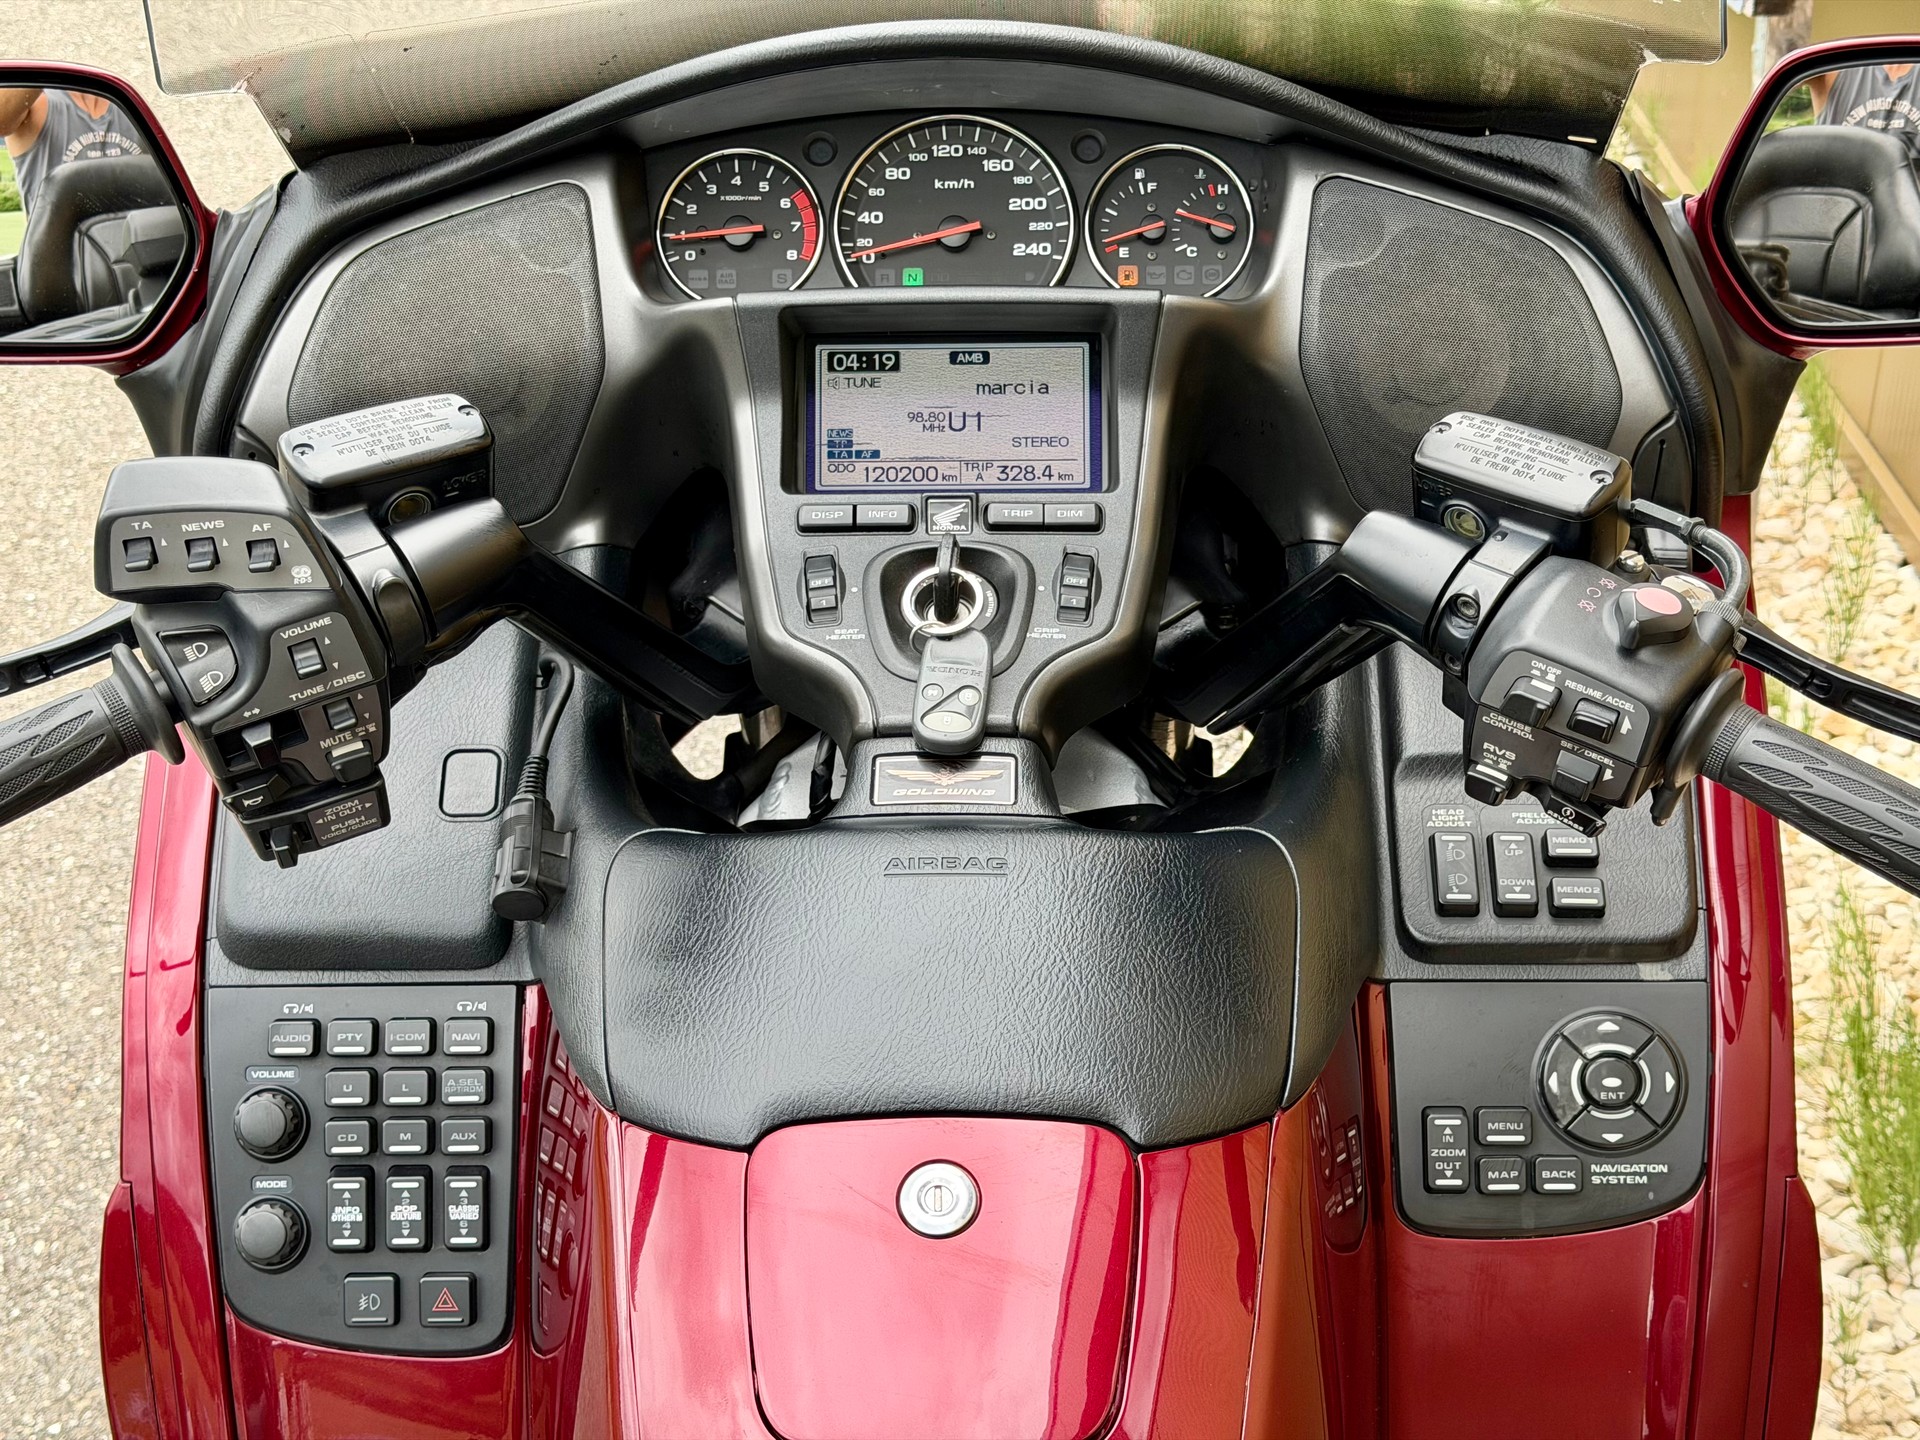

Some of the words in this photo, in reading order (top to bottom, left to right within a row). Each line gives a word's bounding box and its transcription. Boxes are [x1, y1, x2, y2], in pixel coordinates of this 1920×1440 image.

[931, 144, 964, 157] 120
[966, 146, 987, 156] 140
[908, 153, 928, 162] 100
[982, 159, 1014, 172] 160
[884, 168, 911, 180] 80
[730, 175, 742, 186] 4
[934, 179, 975, 189] km/h
[1012, 176, 1033, 185] 180
[706, 184, 717, 195] 3
[758, 181, 770, 192] 5
[1146, 182, 1158, 193] F
[1217, 184, 1229, 195] H
[868, 188, 885, 197] 60
[780, 198, 791, 208] 6
[1008, 198, 1047, 211] 200
[686, 204, 698, 214] 2
[857, 211, 884, 224] 40
[790, 222, 802, 232] 7
[1028, 222, 1053, 231] 220
[856, 238, 873, 247] 20
[786, 250, 798, 260] 8
[1012, 243, 1052, 256] 240
[1118, 247, 1130, 258] E
[1186, 246, 1198, 257] C
[684, 250, 696, 261] 0
[862, 251, 876, 264] 0
[776, 274, 788, 284] S
[907, 273, 918, 282] N
[833, 353, 896, 371] 04:19
[956, 352, 984, 364] AMB
[844, 377, 882, 389] TUNE
[976, 381, 1050, 395] marcia
[907, 412, 946, 423] 98.80
[948, 412, 982, 432] U1
[423, 423, 452, 434] FLUIDE
[828, 429, 854, 438] NEWS
[922, 423, 946, 433] MHz
[1012, 436, 1070, 448] STEREO
[365, 449, 378, 457] DE
[833, 450, 848, 458] TA
[861, 450, 873, 458] AF
[1495, 445, 1538, 462] WARNING
[1470, 456, 1483, 464] DE
[1485, 460, 1510, 472] FREIN
[827, 464, 856, 473] ODO
[864, 466, 939, 483] 120200
[942, 472, 958, 482] km
[964, 462, 994, 472] TRIP
[996, 465, 1054, 482] 328.4
[1058, 471, 1074, 481] km
[976, 472, 985, 482] A
[1537, 467, 1567, 482] FLUIDE
[812, 511, 844, 519] DISP
[868, 510, 898, 518] INFO
[1002, 509, 1033, 518] TRIP
[1056, 509, 1083, 518] DIM
[131, 521, 153, 531] TA
[182, 520, 225, 532] NEWS
[252, 523, 272, 533] AF
[280, 617, 333, 639] VOLUME
[926, 666, 984, 678] HONDA
[1531, 660, 1546, 671] ON
[1546, 665, 1562, 676] OFF
[289, 671, 366, 701] TUNE/DISC
[1564, 679, 1636, 713] RESUME/ACCEL
[1489, 712, 1532, 734] CRUISE
[1482, 716, 1535, 742] CONTROL
[320, 732, 353, 749] MUTE
[1483, 742, 1516, 760] RVS
[1560, 740, 1616, 767] SET/DECEL
[1483, 752, 1498, 761] ON
[1498, 758, 1512, 766] OFF
[892, 788, 996, 797] GOLDWING
[324, 800, 360, 815] ZOOM
[339, 805, 363, 817] OUT
[331, 816, 365, 832] PUSH
[1547, 810, 1584, 831] REVERSE
[321, 818, 378, 840] VOICE/GUIDE
[884, 856, 1009, 871] AIRBAG
[272, 1034, 311, 1042] AUDIO
[337, 1033, 363, 1042] PTY
[451, 1032, 480, 1041] NAVI
[251, 1070, 295, 1078] VOLUME
[342, 1084, 352, 1092] U
[401, 1083, 409, 1091] L
[1487, 1122, 1524, 1130] MENU
[337, 1134, 358, 1142] CD
[400, 1132, 412, 1141] M
[450, 1132, 477, 1140] AUX
[1435, 1162, 1462, 1170] OUT
[1590, 1164, 1668, 1173] NAVIGATION
[1488, 1170, 1519, 1179] MAP
[1542, 1170, 1576, 1178] BACK
[1591, 1175, 1648, 1184] SYSTEM
[255, 1180, 288, 1188] MODE
[331, 1213, 355, 1222] OTHER
[390, 1212, 422, 1220] CULTURE
